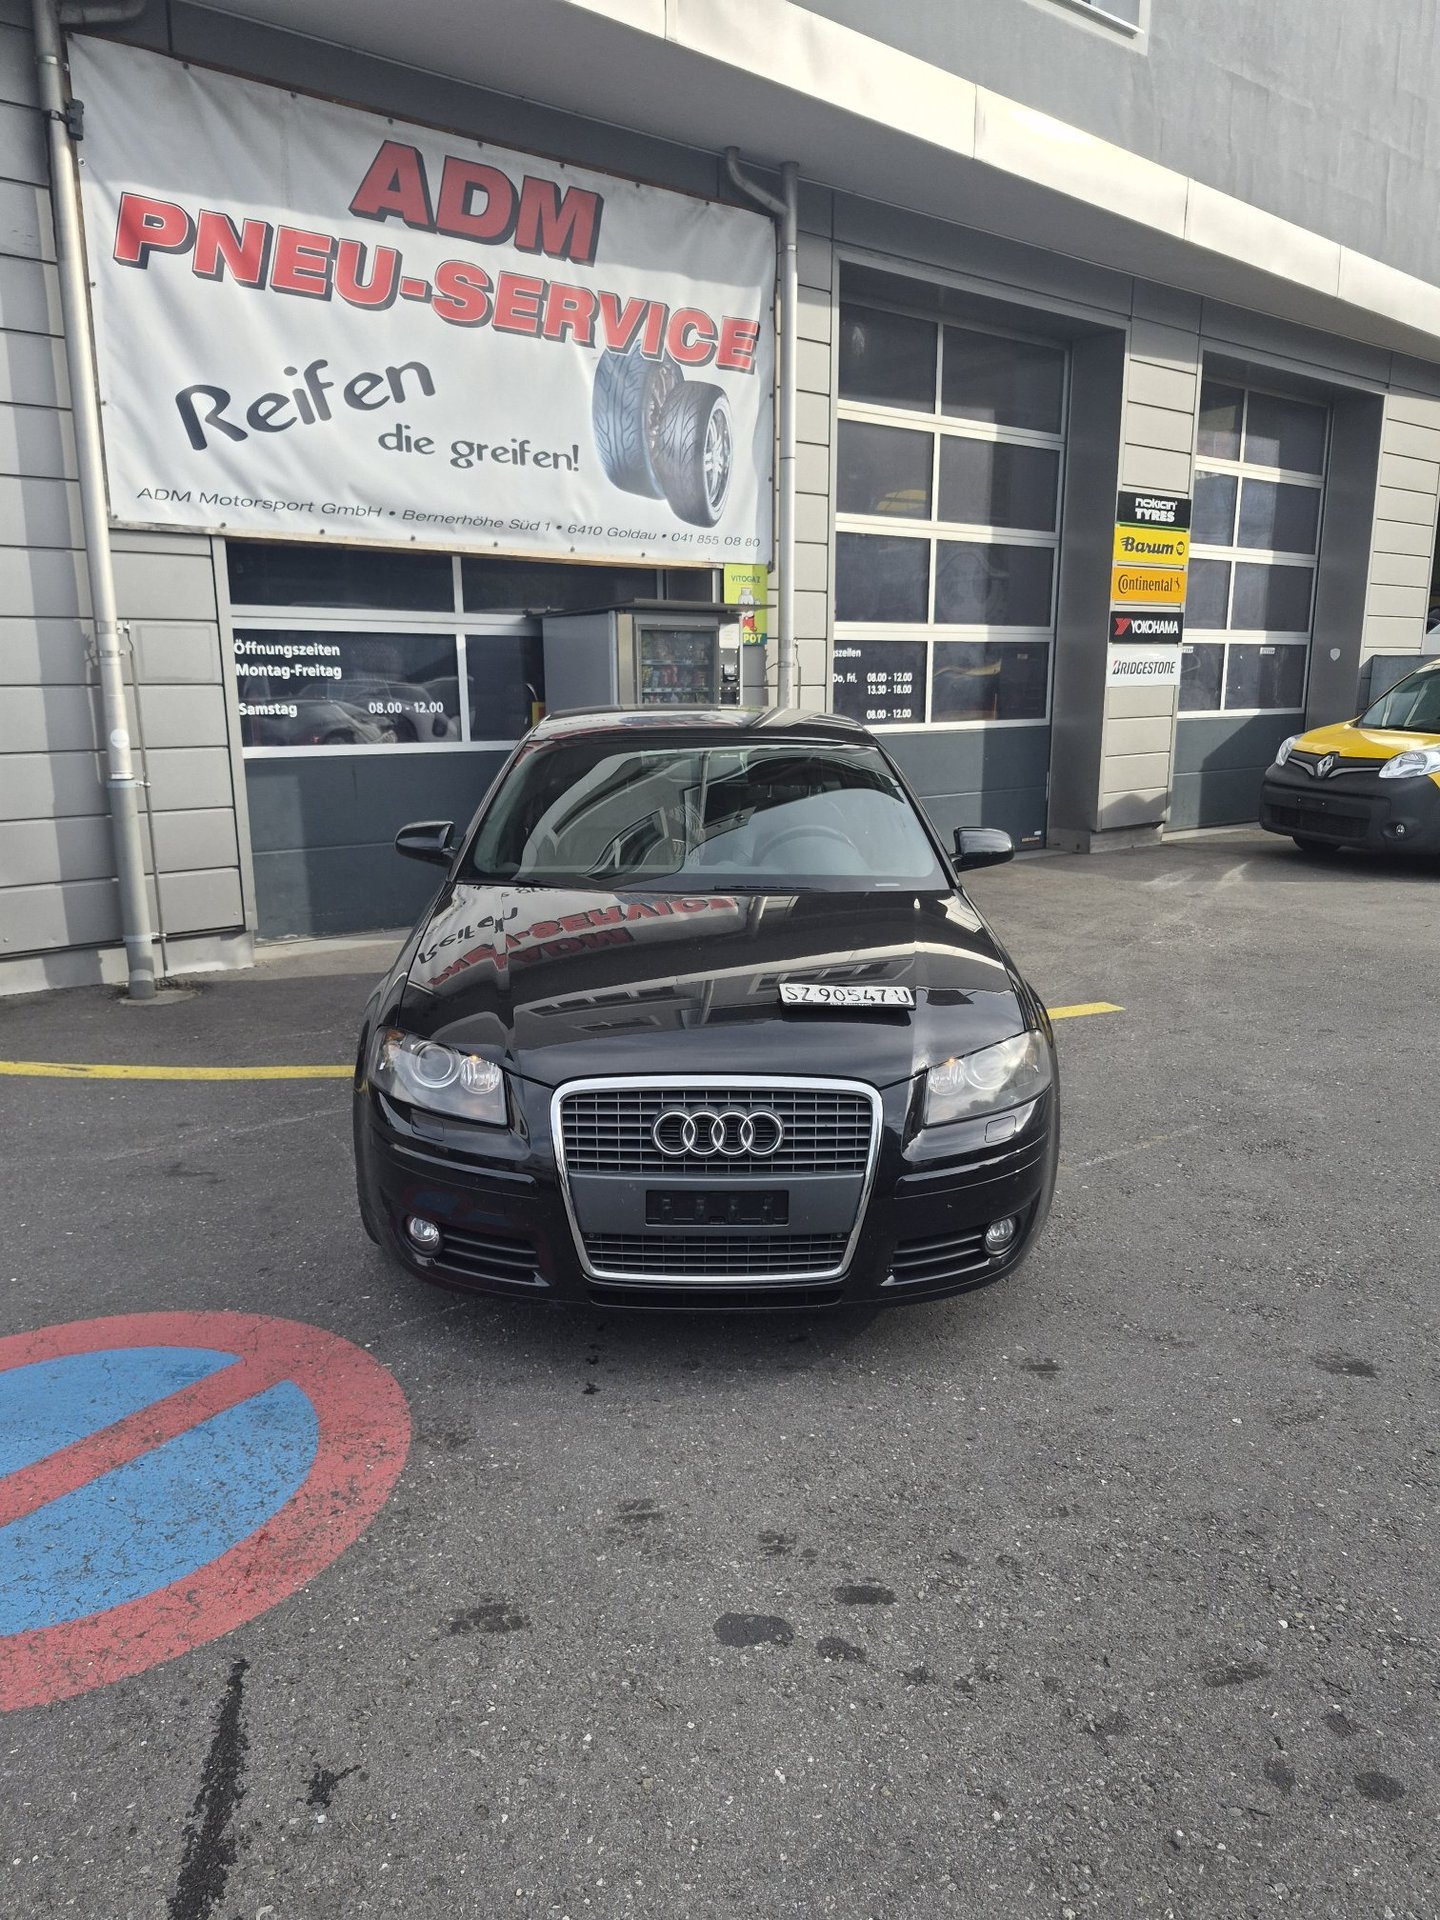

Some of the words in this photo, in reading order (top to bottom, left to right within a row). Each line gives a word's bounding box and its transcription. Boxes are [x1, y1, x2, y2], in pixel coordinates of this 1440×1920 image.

[349, 140, 604, 267] ADM
[113, 191, 760, 375] PNEU-SERVICE
[175, 358, 436, 450] Reifen
[378, 424, 436, 457] die
[450, 437, 580, 473] greifen!
[137, 488, 191, 503] ADM
[199, 492, 315, 513] Motorsport
[321, 502, 382, 518] GmbH
[402, 509, 504, 529] Bernerhöhe
[508, 518, 540, 531] Süd
[542, 522, 551, 532] 1
[567, 524, 602, 536] 6410
[607, 526, 657, 541] Goldau
[671, 532, 694, 543] 041
[697, 534, 719, 545] 855
[724, 536, 742, 546] 08
[745, 537, 761, 548] 80
[1135, 508, 1175, 522] TYRES
[1120, 536, 1174, 555] Barum
[1118, 574, 1173, 594] Continental
[1130, 620, 1179, 634] YOKOHAMA
[743, 633, 762, 644] POT
[233, 639, 341, 658] Öffnungszeiten
[235, 664, 342, 679] Montag-Freitag
[1112, 660, 1176, 675] BRIDGESTONE
[866, 672, 887, 682] 08.00
[893, 672, 913, 682] 12.00
[867, 685, 887, 694] 13.30
[893, 684, 912, 694] 18.00
[238, 702, 298, 717] Samstag
[368, 702, 402, 714] 08.00
[413, 702, 444, 713] 12.00
[866, 709, 887, 719] 08.00
[892, 708, 912, 718] 12.00
[785, 986, 813, 1002] SZ
[818, 988, 887, 1003] 90547
